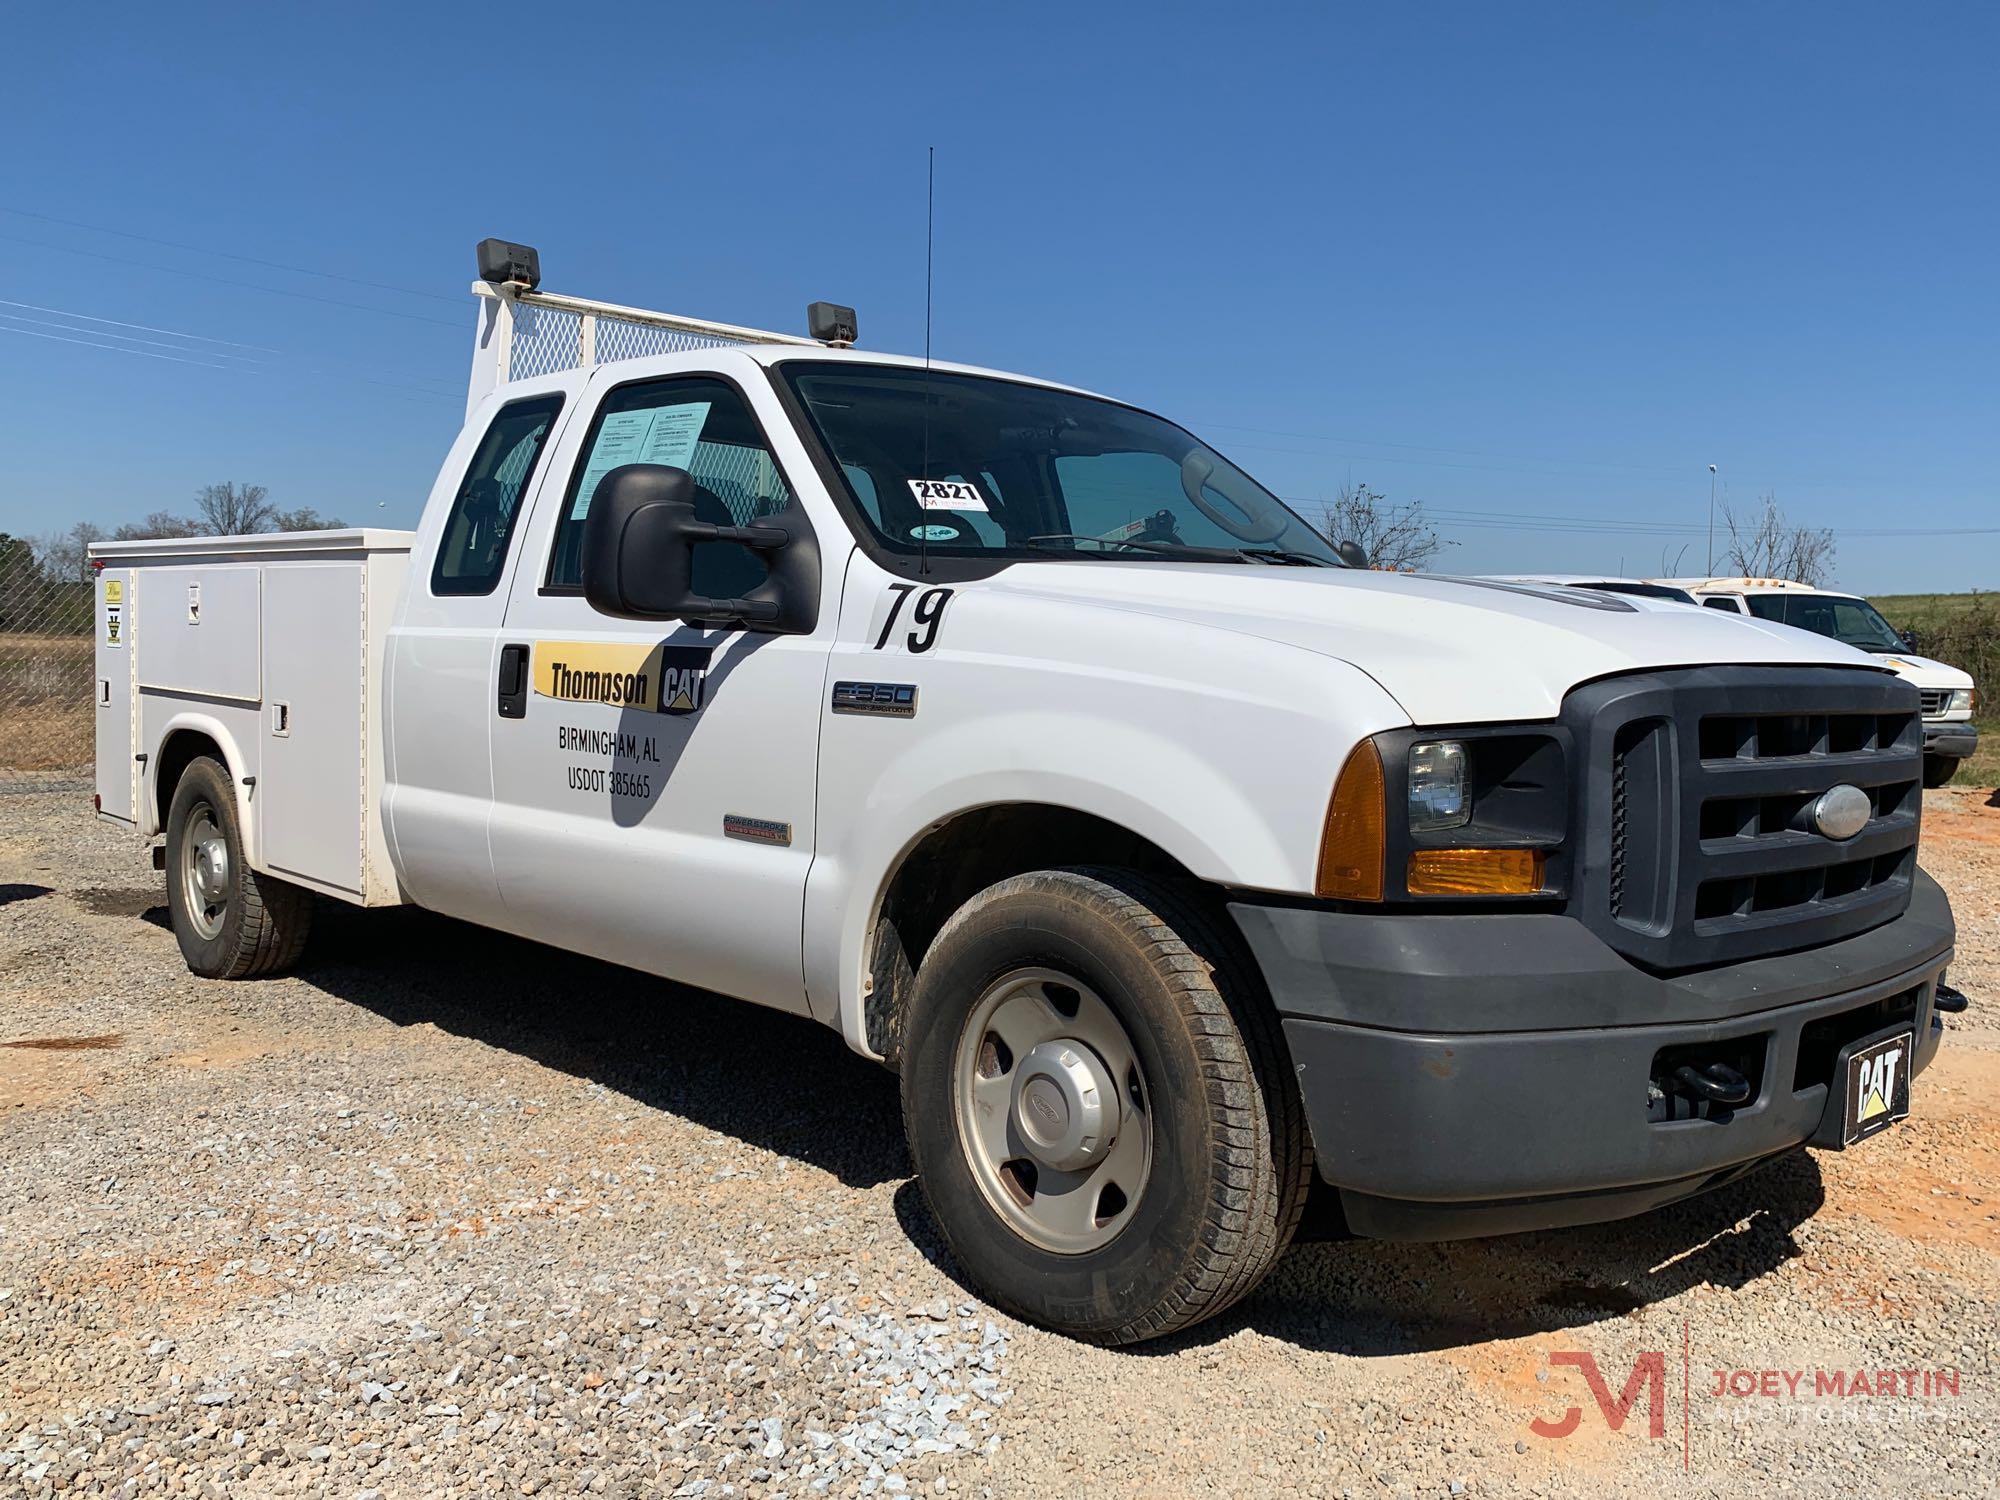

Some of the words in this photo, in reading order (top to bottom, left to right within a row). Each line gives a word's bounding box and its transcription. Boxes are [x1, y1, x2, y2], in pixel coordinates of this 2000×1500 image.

[915, 482, 978, 500] 2821
[873, 583, 955, 654] 79
[552, 663, 648, 705] Thompson
[663, 667, 706, 710] CAT
[559, 726, 640, 765] BIRMINGHAM,
[642, 736, 661, 763] AL
[568, 766, 606, 793] USDOT
[608, 771, 651, 799] 385665
[1857, 1048, 1902, 1123] CAT
